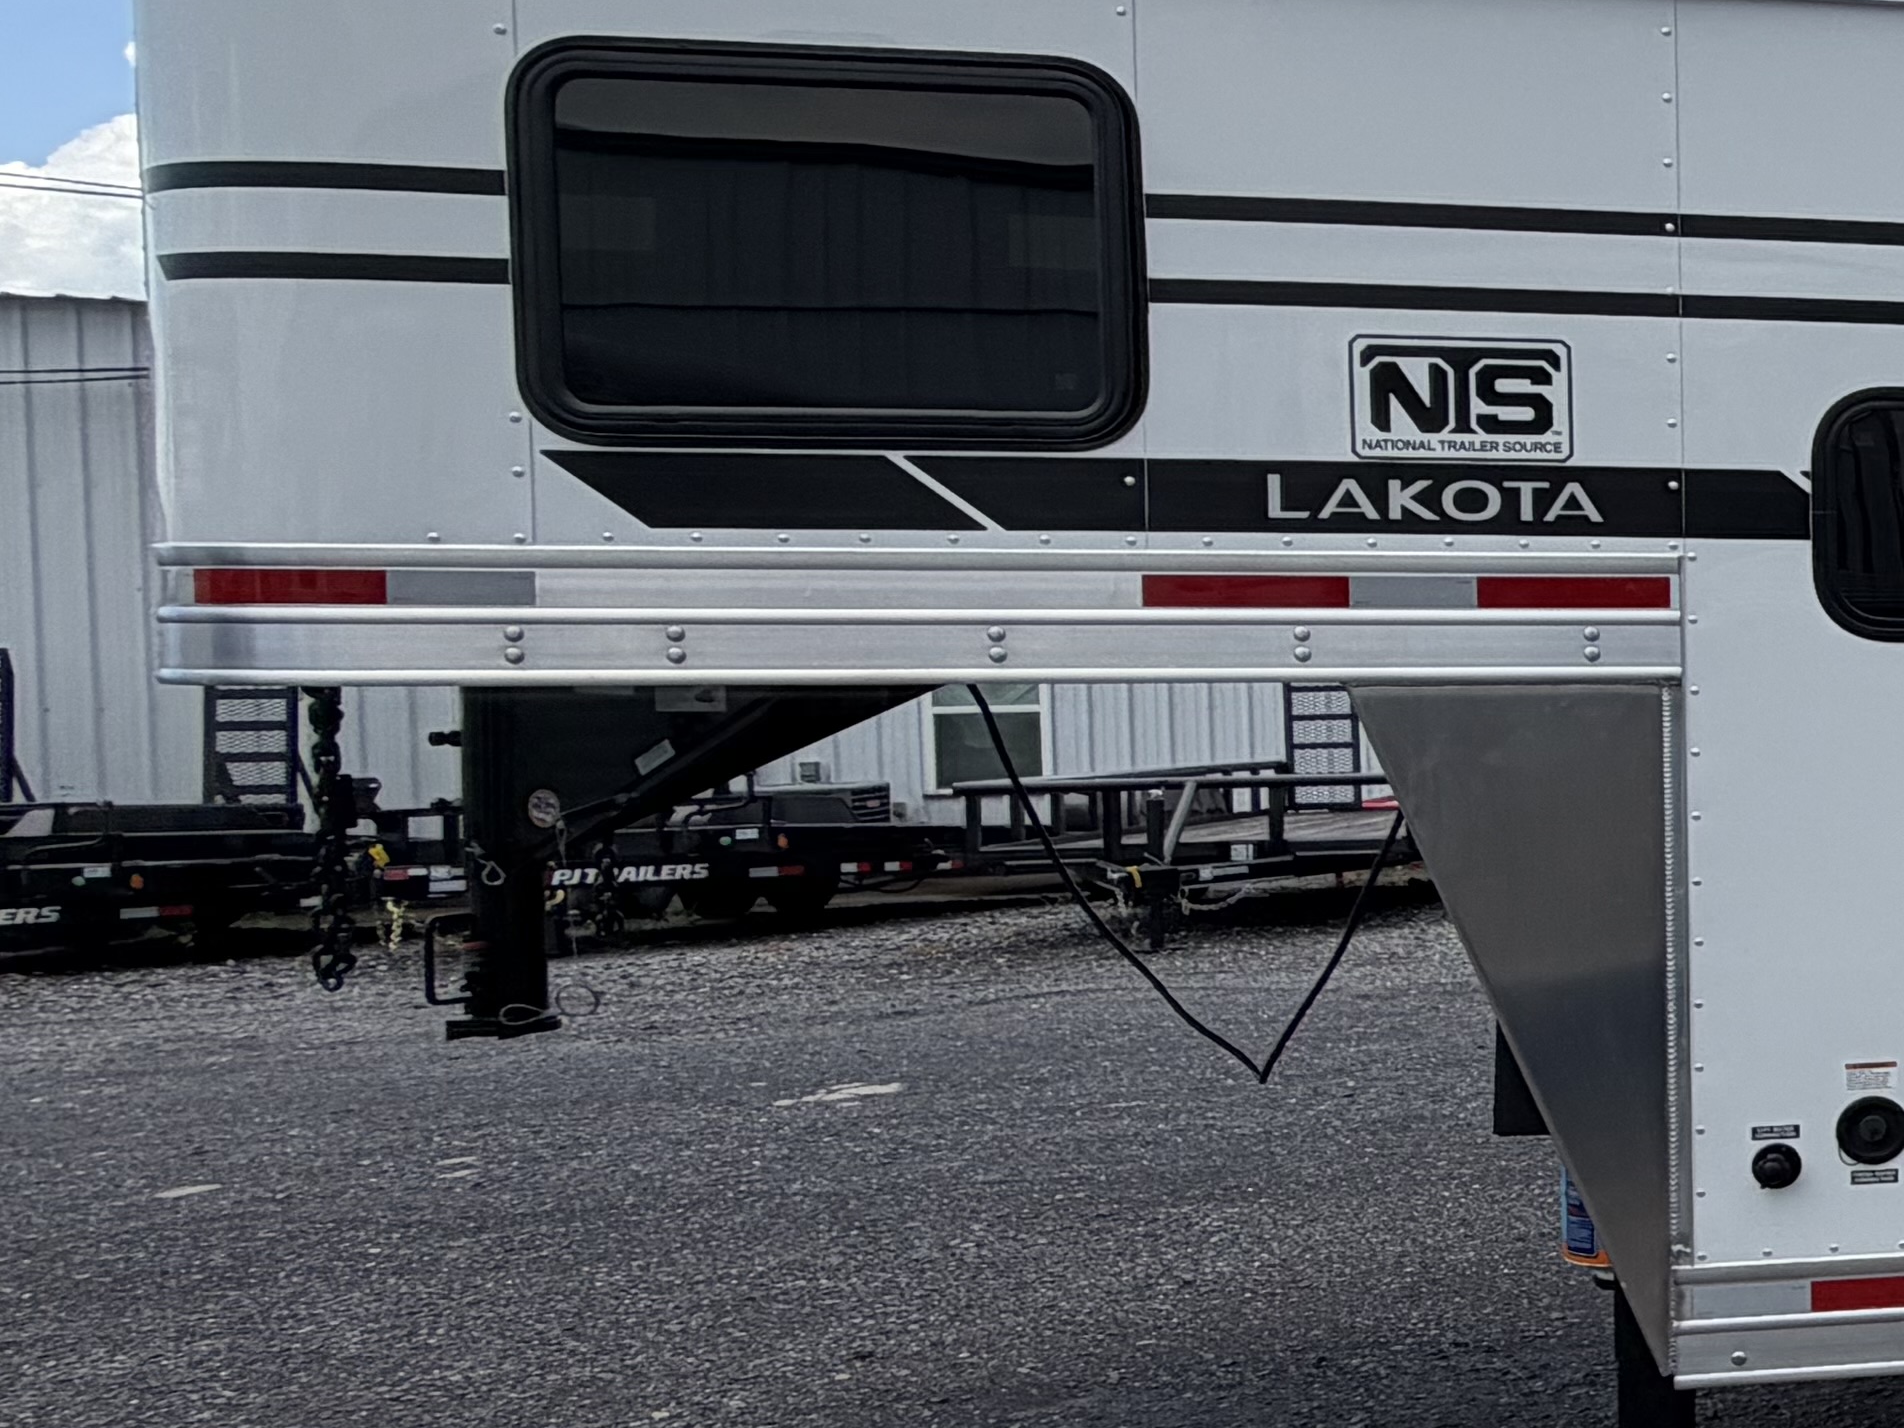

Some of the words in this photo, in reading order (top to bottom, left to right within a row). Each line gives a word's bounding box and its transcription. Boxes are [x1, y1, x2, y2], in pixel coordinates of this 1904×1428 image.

[1361, 438, 1436, 452] NATIONAL
[1438, 439, 1499, 453] TRAILER
[1502, 441, 1563, 454] SOURCE
[1267, 473, 1604, 522] LAKOTA
[584, 863, 709, 884] TAILERS
